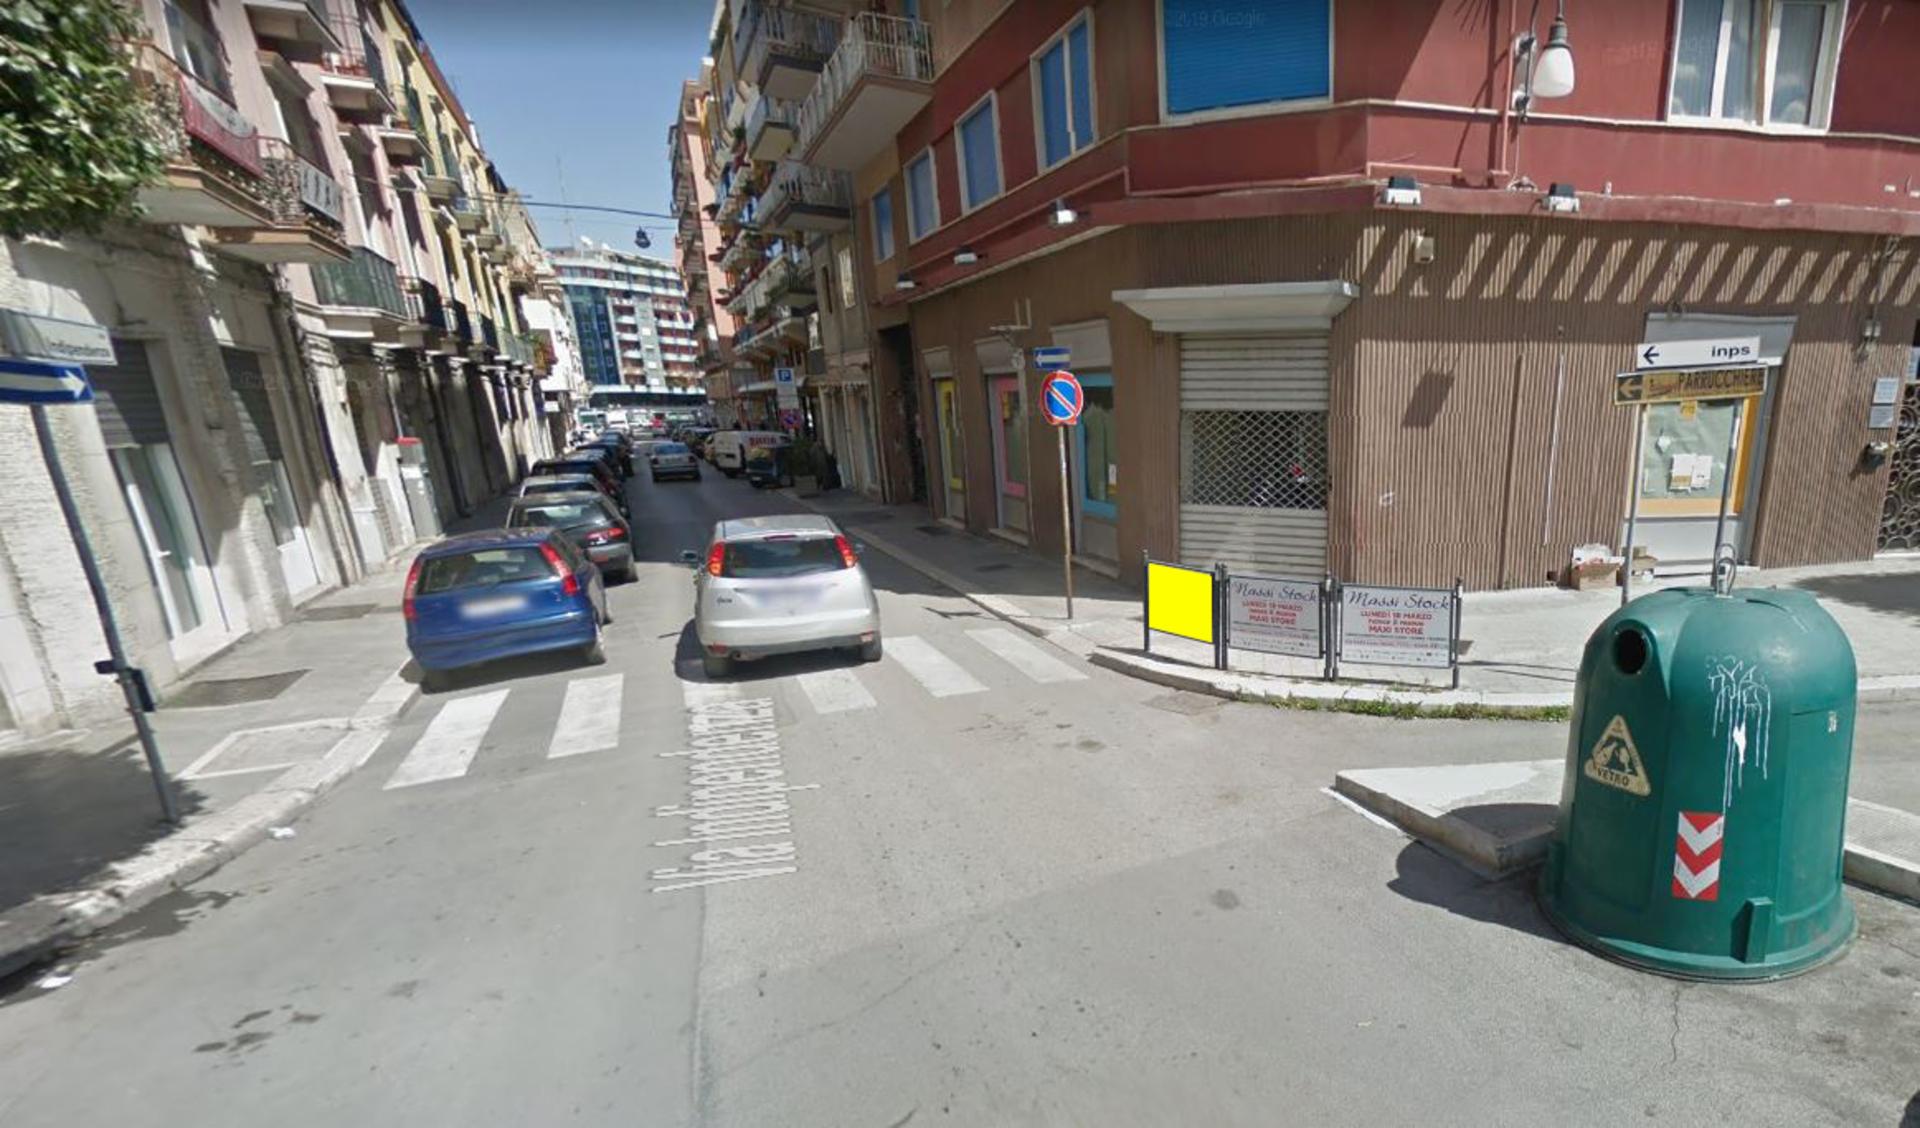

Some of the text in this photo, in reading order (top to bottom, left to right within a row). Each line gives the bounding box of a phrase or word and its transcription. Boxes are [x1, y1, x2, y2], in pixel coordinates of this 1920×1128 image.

[1711, 345, 1751, 359] inps
[1279, 585, 1317, 602] Stock
[1345, 590, 1450, 610] Massi Stock
[1271, 616, 1296, 625] STORE
[1368, 625, 1424, 635] MAXI STORE
[1594, 766, 1630, 787] VETRO
